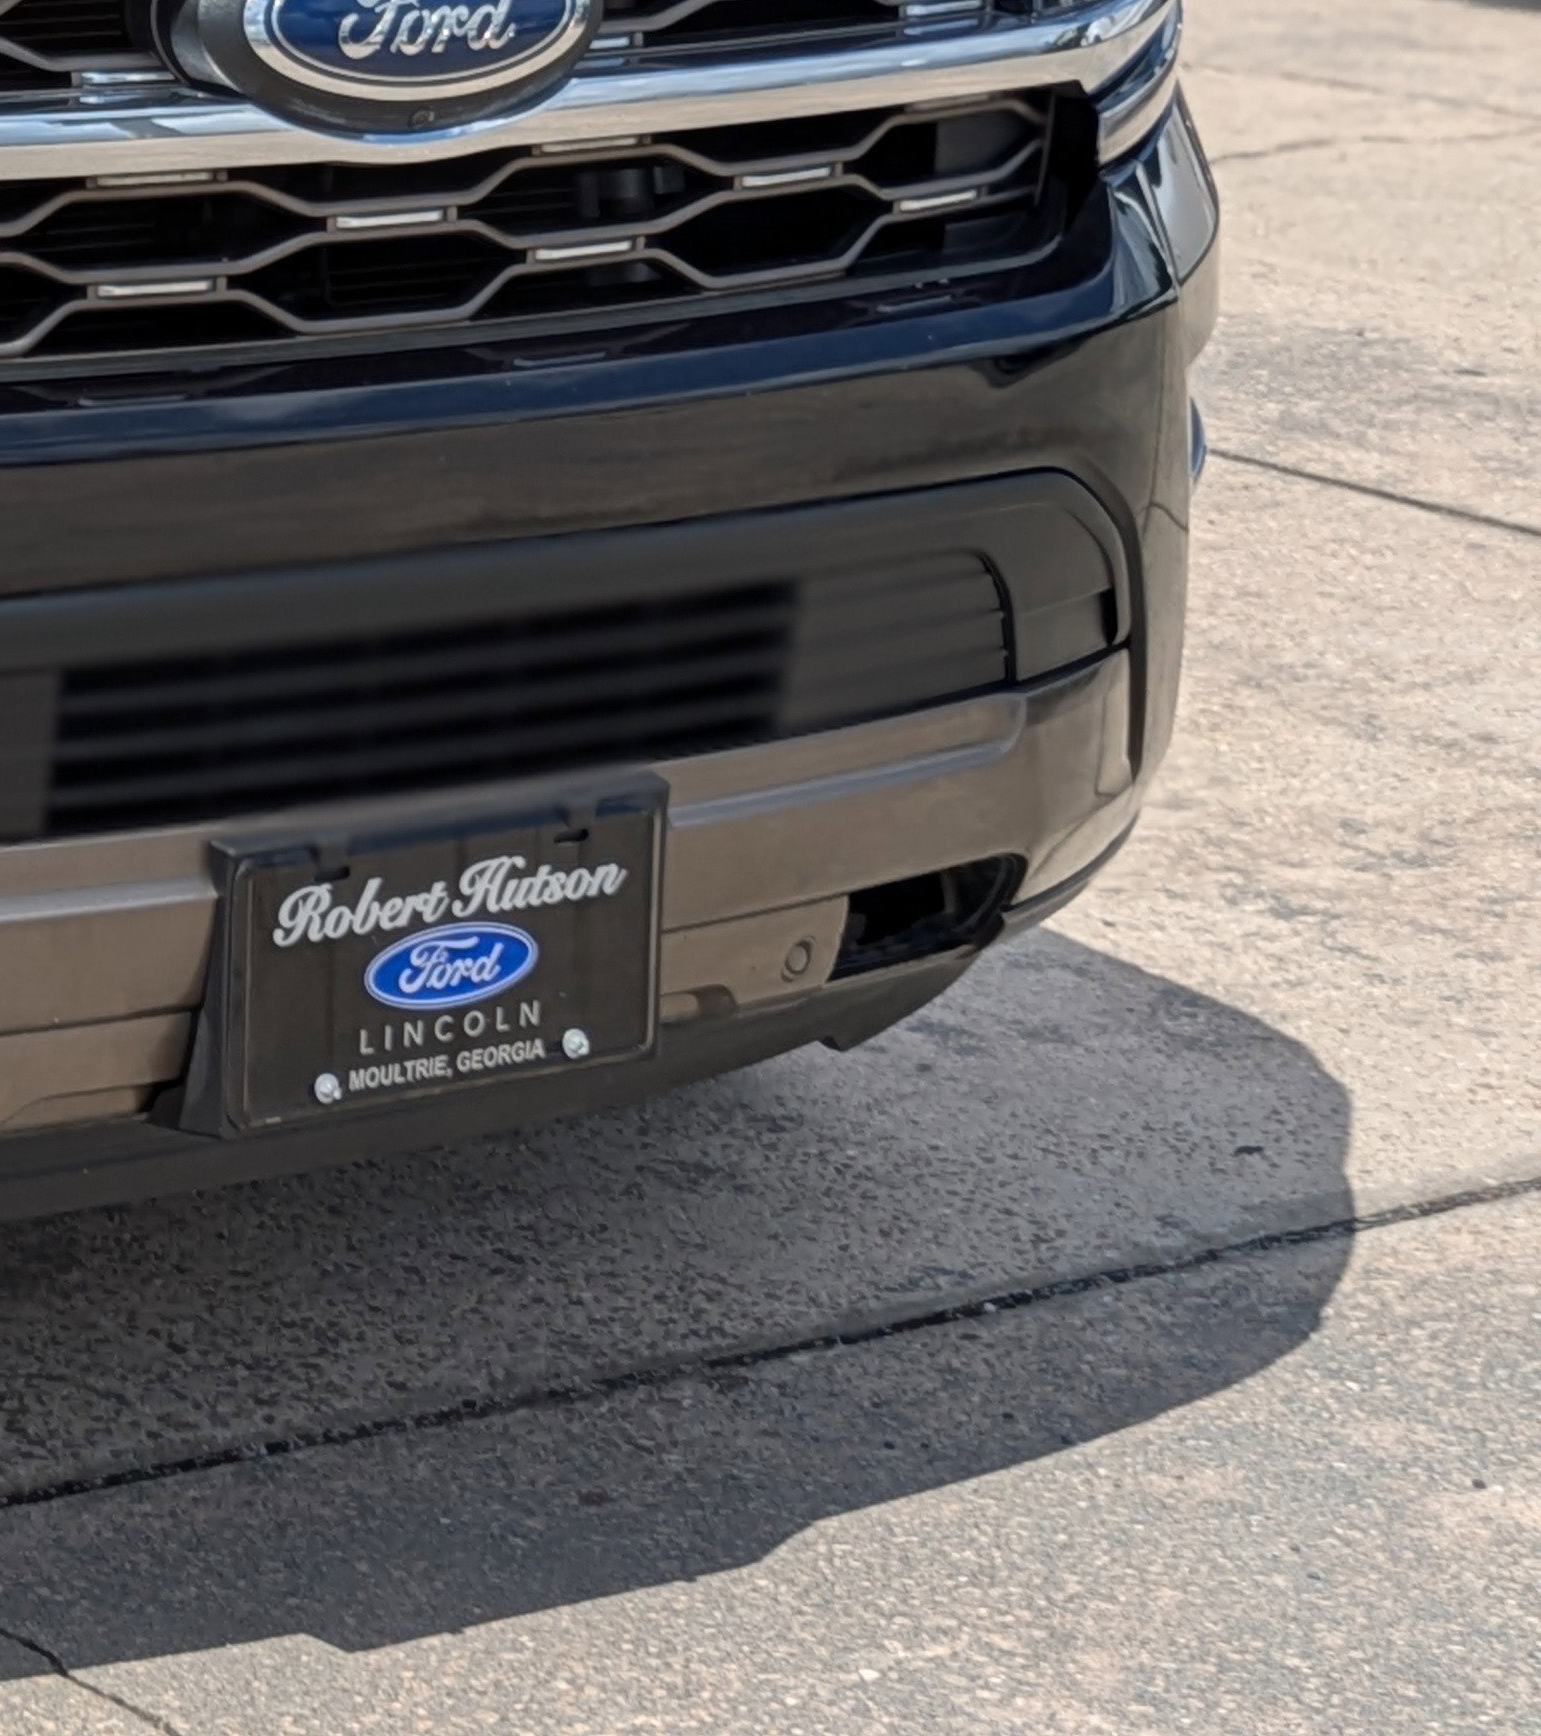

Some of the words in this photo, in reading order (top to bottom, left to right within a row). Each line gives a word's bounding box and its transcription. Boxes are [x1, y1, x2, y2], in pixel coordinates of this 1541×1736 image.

[272, 876, 451, 948] Robert
[451, 854, 629, 918] Hutson
[398, 935, 505, 994] Ford
[359, 998, 541, 1056] LINCOLN
[348, 1053, 454, 1093] MOULTRIE,
[455, 1037, 547, 1073] GEORGIA
